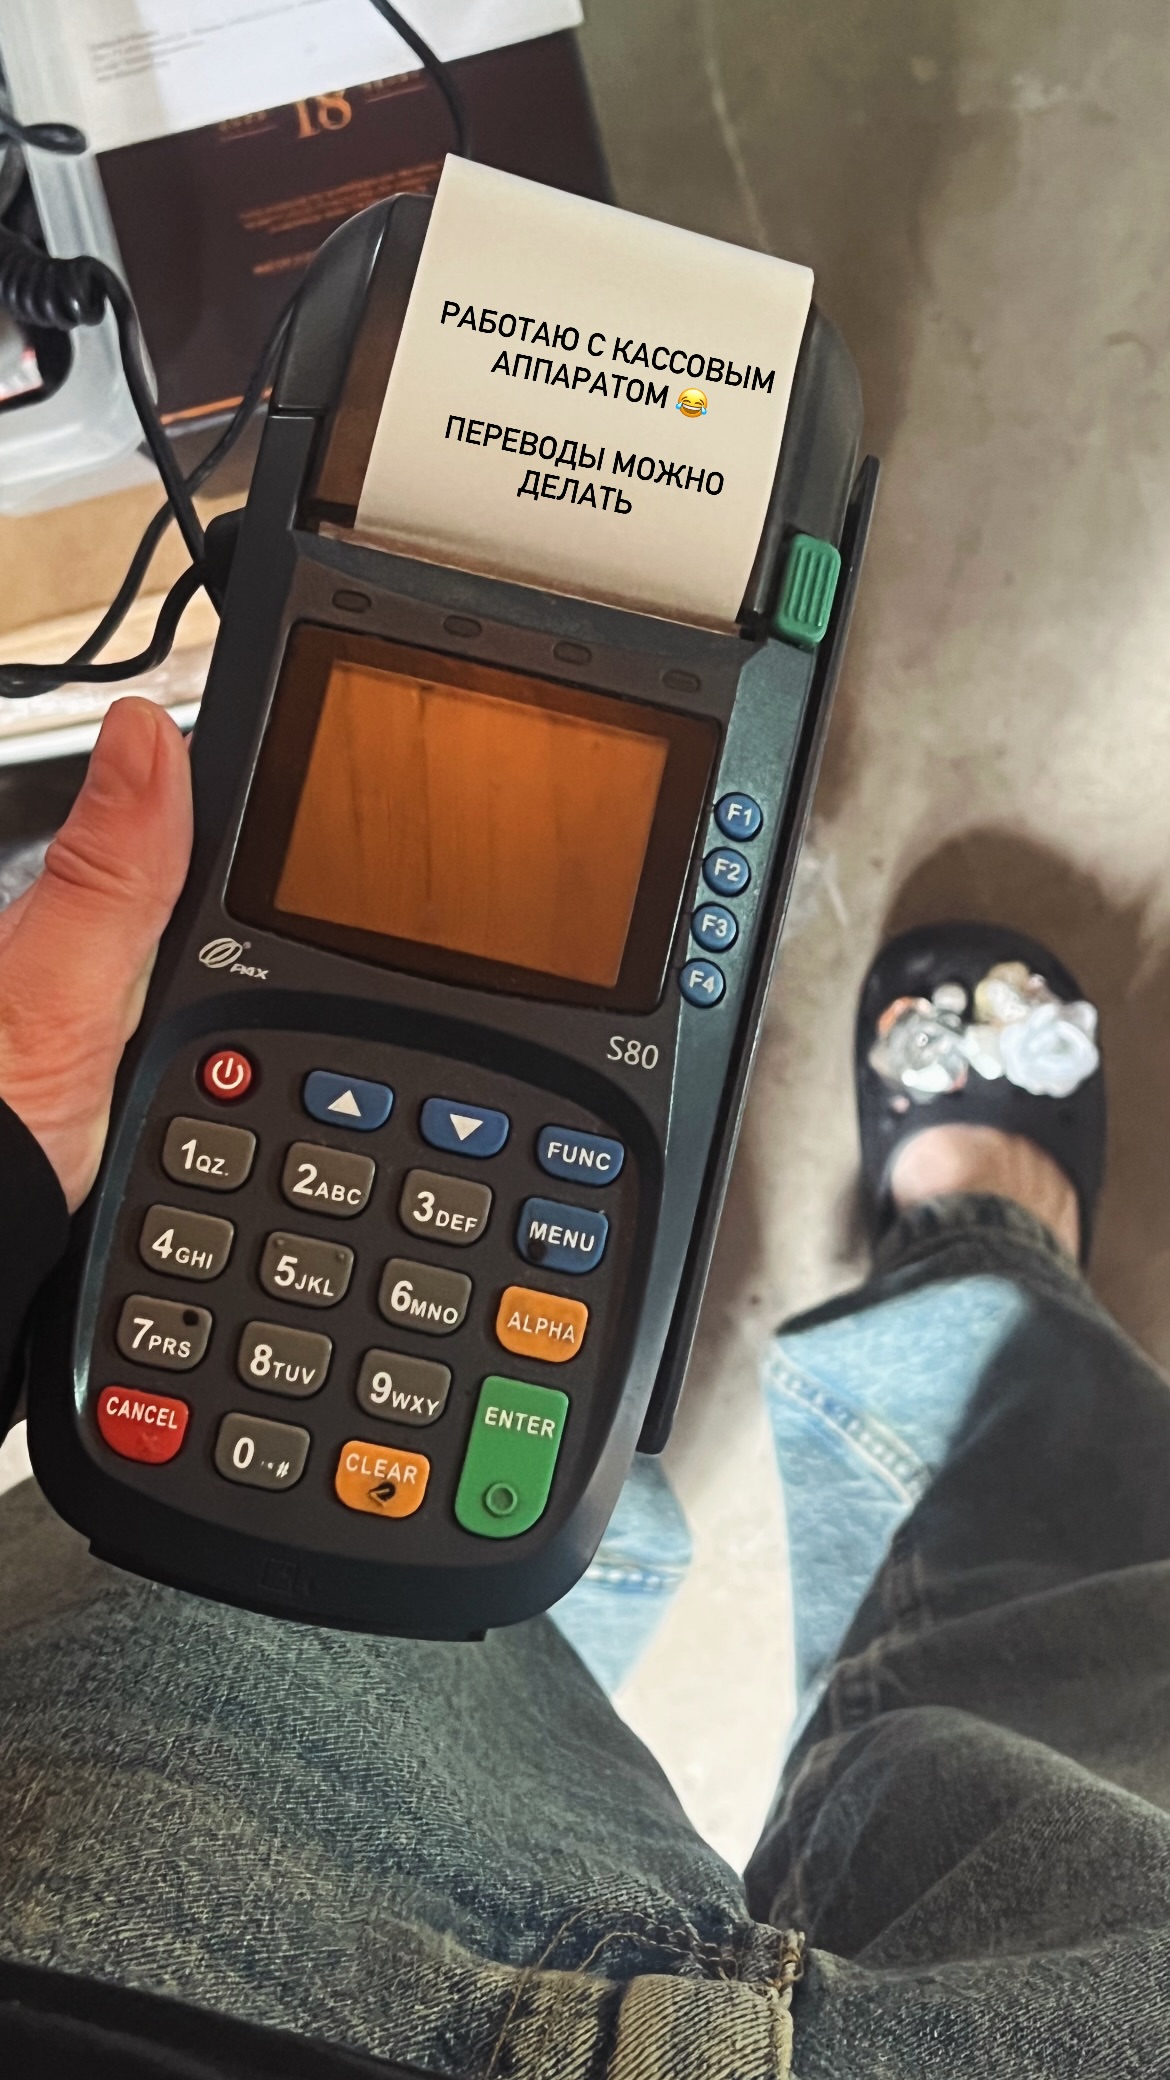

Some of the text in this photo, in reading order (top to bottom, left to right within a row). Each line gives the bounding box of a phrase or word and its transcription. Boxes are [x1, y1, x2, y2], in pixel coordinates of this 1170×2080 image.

[727, 803, 752, 827] F1
[714, 858, 741, 882] F2
[702, 914, 728, 937] F3
[689, 969, 715, 993] F4
[606, 1036, 659, 1070] S80
[547, 1141, 611, 1171] FUNC
[529, 1220, 595, 1252] MENU
[507, 1311, 575, 1344] ALPHA
[106, 1396, 178, 1429] CANCEL
[484, 1406, 556, 1438] ENTER
[345, 1453, 418, 1484] CLEAR
